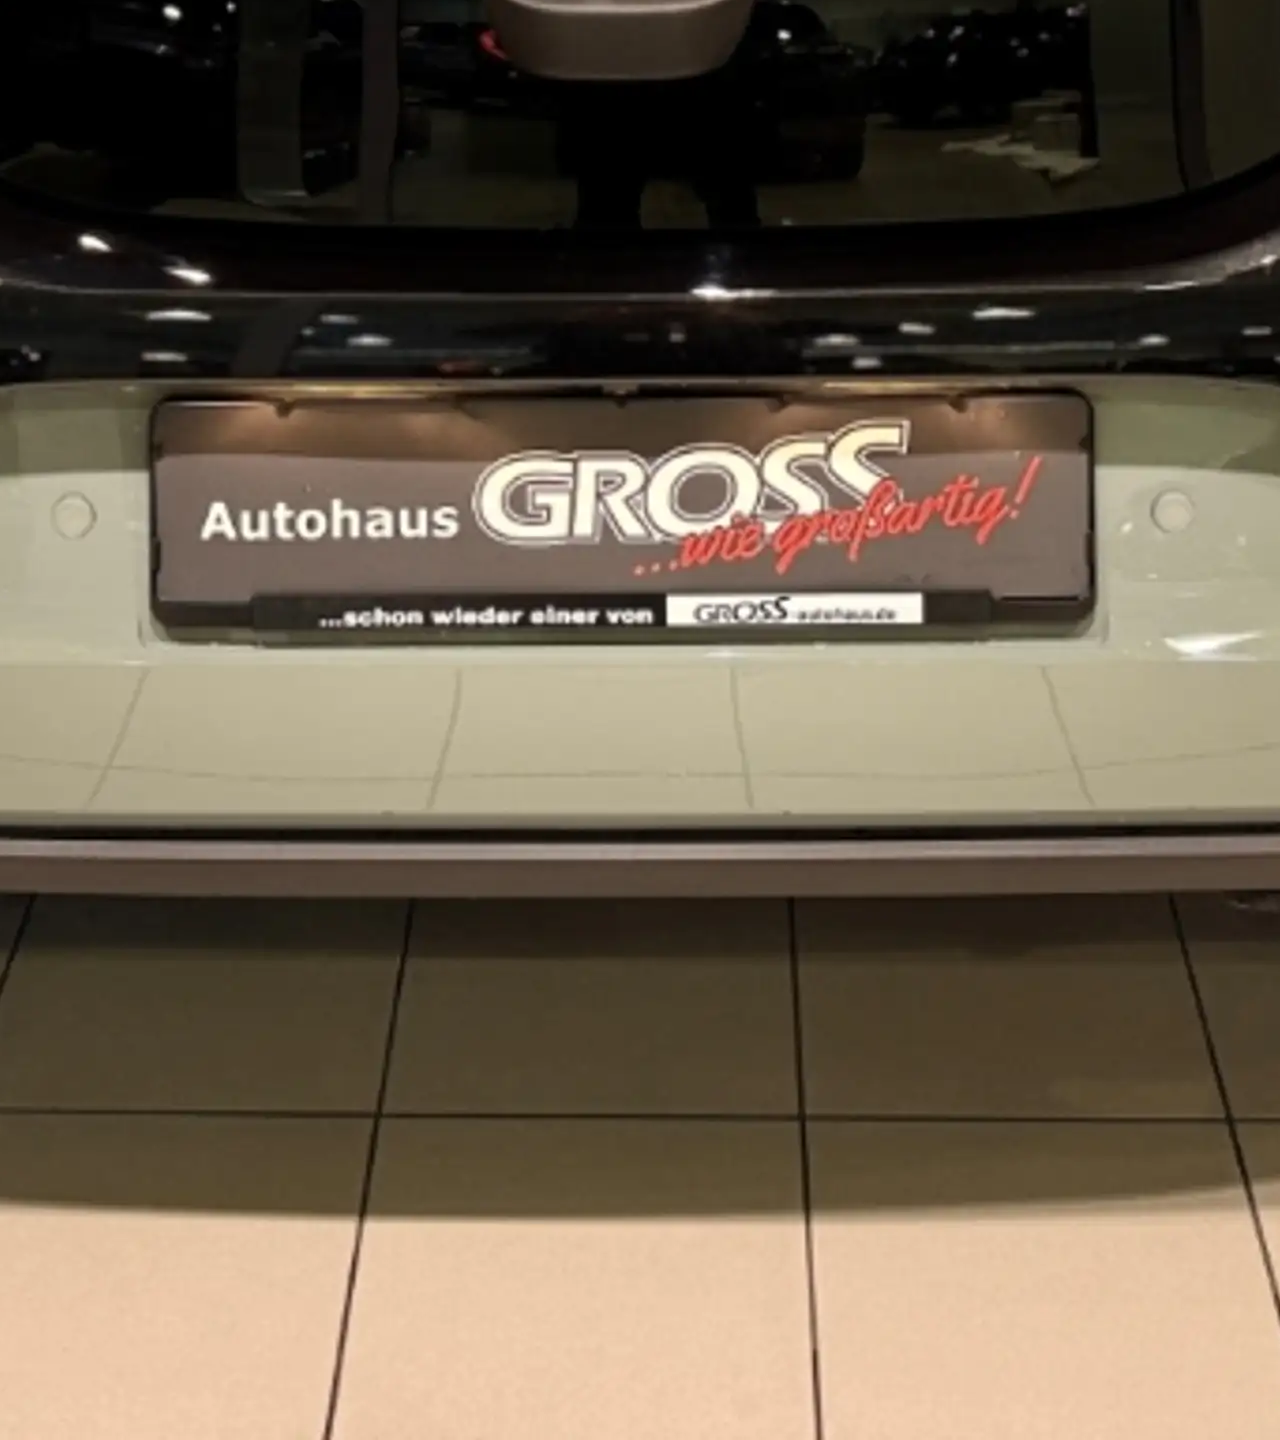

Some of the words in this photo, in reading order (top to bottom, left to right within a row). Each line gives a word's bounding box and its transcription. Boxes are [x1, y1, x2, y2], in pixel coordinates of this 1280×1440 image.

[200, 498, 461, 542] Autohaus
[471, 419, 911, 547] GROSS
[772, 454, 1042, 576] großartig!
[430, 605, 523, 626] wieder
[530, 603, 599, 625] einer
[605, 607, 654, 625] von
